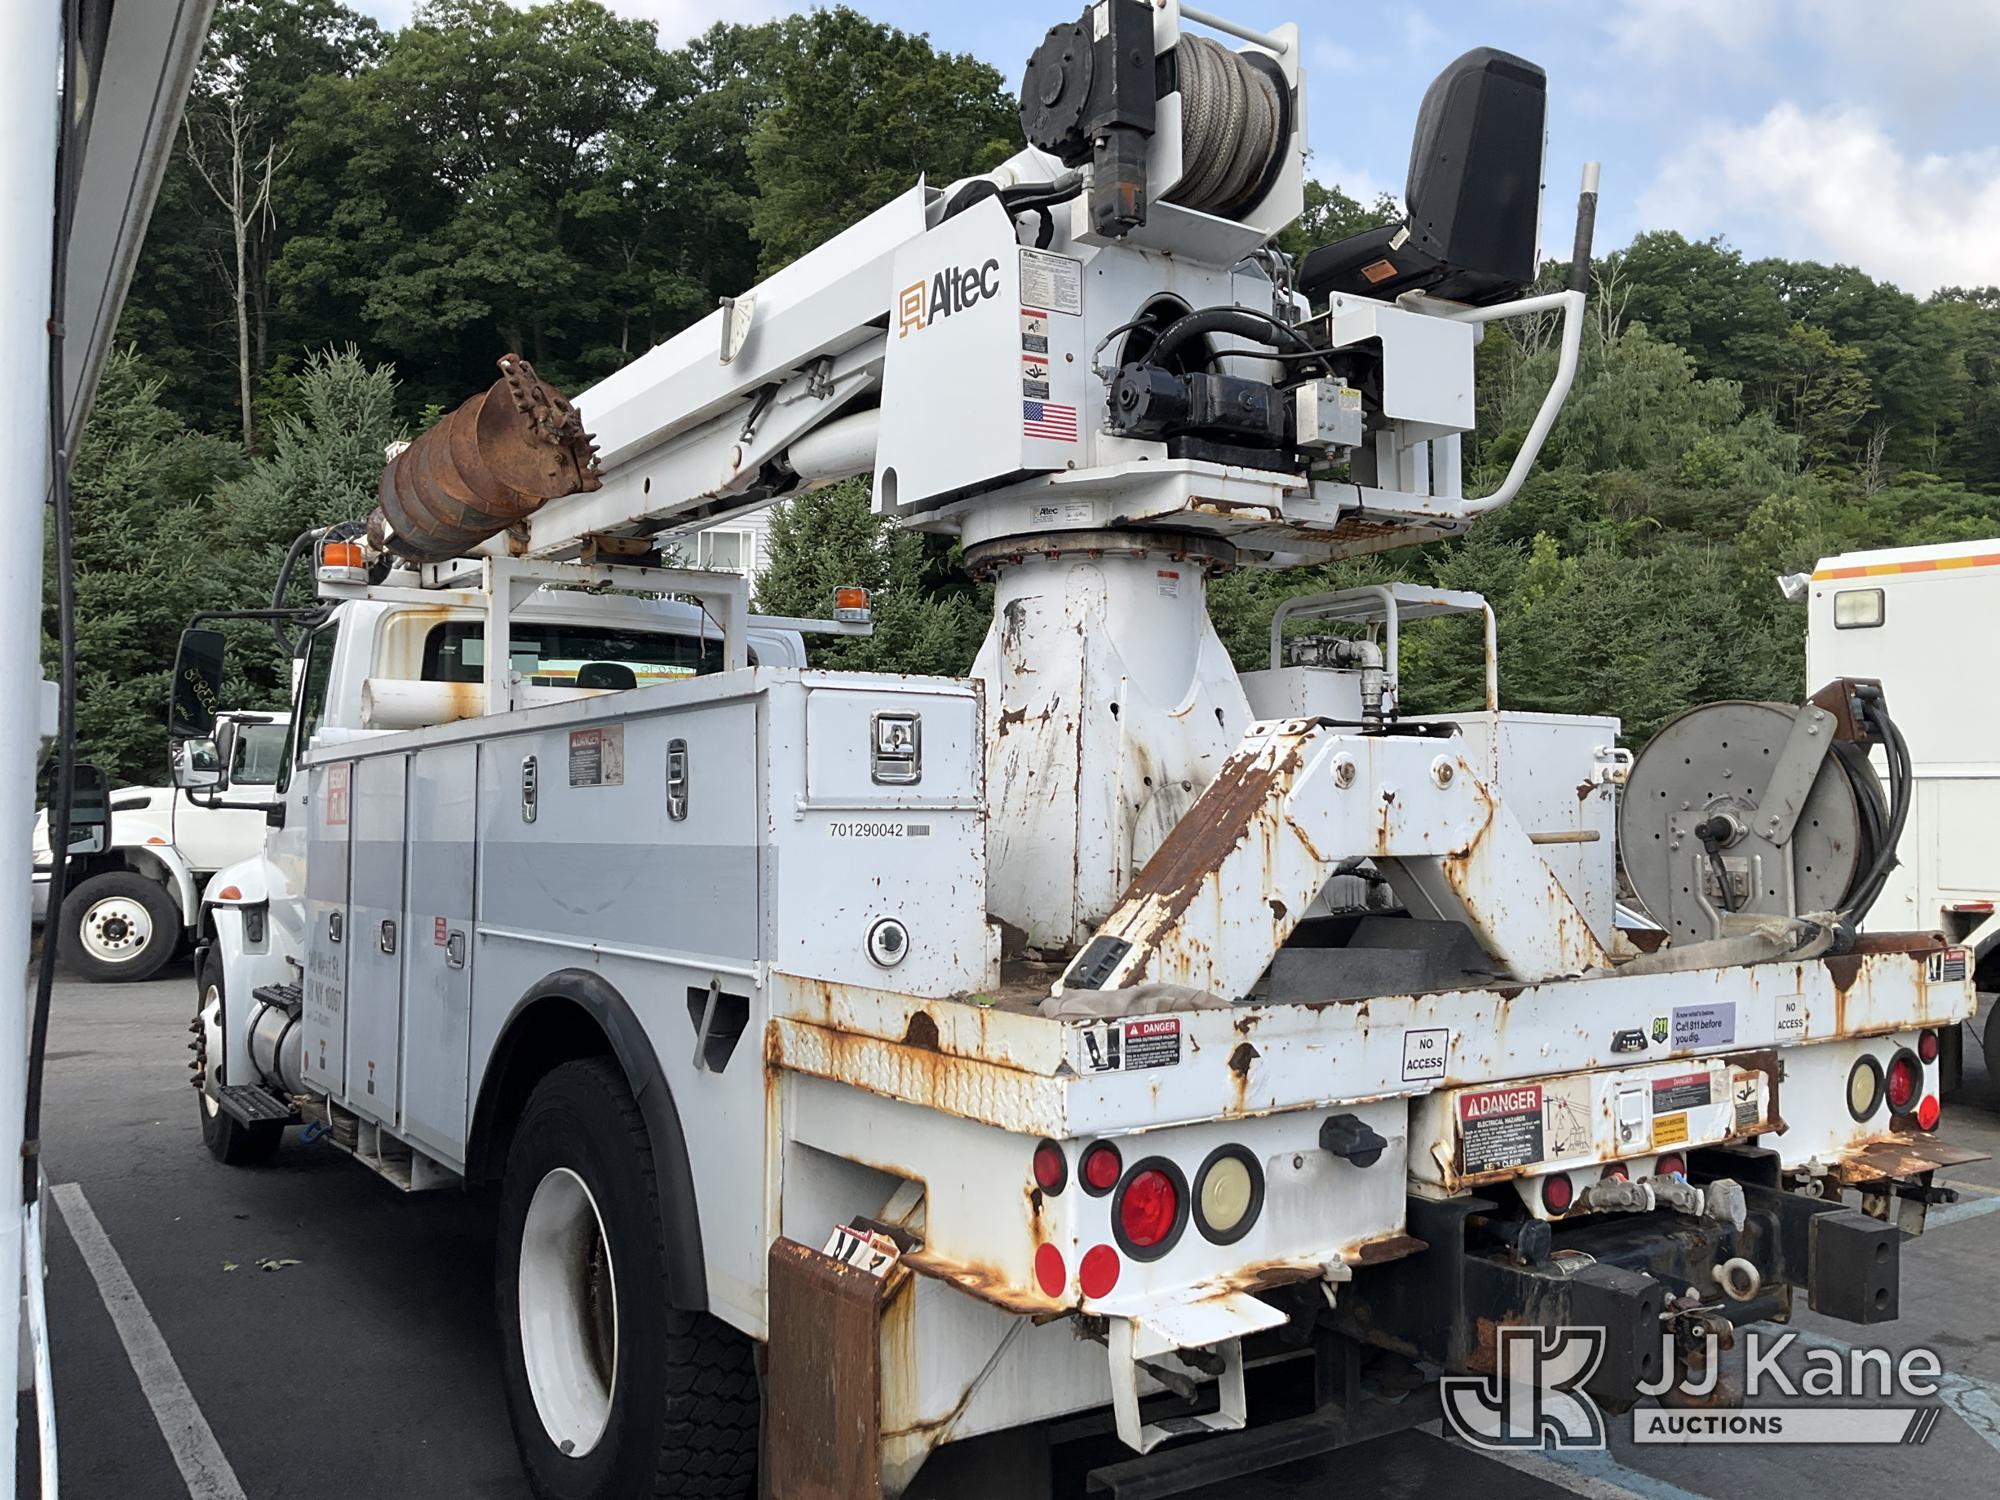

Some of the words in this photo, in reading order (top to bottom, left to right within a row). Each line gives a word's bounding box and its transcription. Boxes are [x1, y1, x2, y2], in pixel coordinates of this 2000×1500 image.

[927, 258, 1000, 325] Altec
[1040, 507, 1059, 516] Altec
[830, 823, 903, 837] 701290042
[1785, 1002, 1796, 1012] NO
[1143, 1021, 1176, 1034] DANGER
[1653, 1018, 1668, 1034] 811
[1675, 1021, 1689, 1032] Call
[1690, 1020, 1700, 1031] 811
[1700, 1019, 1722, 1029] before
[1778, 1018, 1804, 1030] ACCESS
[1419, 1038, 1434, 1050] NO
[1675, 1033, 1689, 1046] you
[1689, 1032, 1700, 1044] dig.
[1406, 1057, 1443, 1071] ACCESS
[1673, 1075, 1693, 1086] DANGER
[1480, 1090, 1536, 1115] DANGER
[1477, 1118, 1504, 1128] ELECTRICAL
[1504, 1115, 1526, 1123] HAZARDS
[1502, 1158, 1522, 1169] CLEAR
